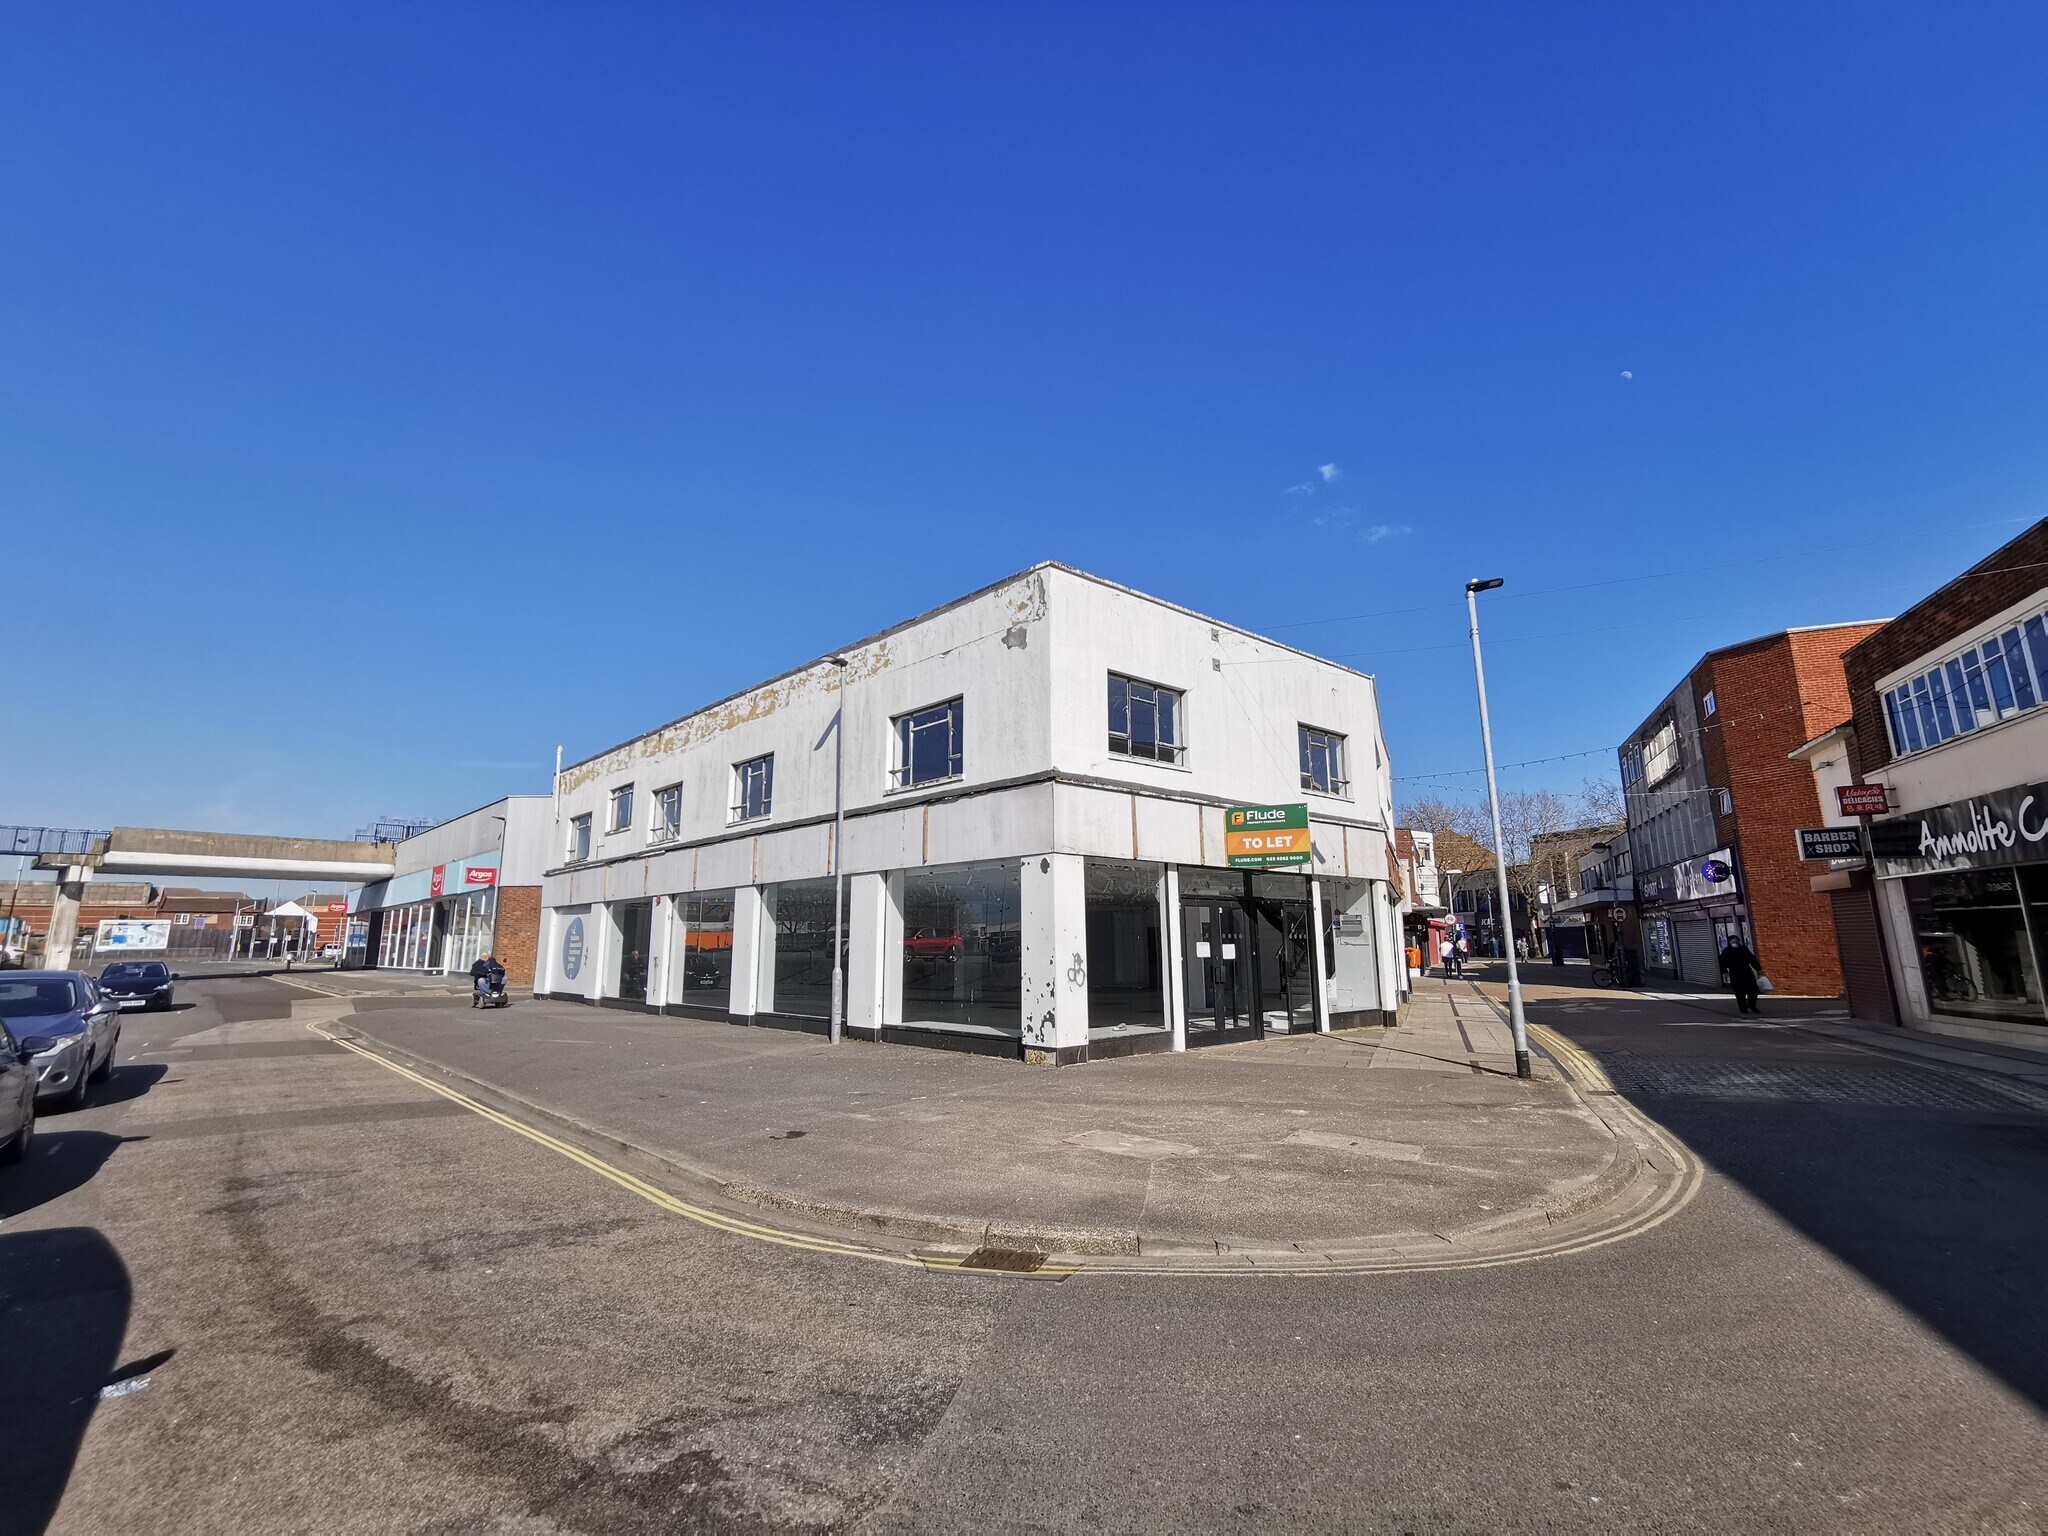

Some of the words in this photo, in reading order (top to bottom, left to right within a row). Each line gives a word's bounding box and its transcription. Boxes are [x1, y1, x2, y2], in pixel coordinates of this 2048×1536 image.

[1842, 796, 1884, 804] DELICACIES
[1246, 809, 1285, 820] Flude
[1918, 800, 2016, 860] Ammolite
[2019, 796, 2048, 841] C
[1243, 837, 1263, 849] TO
[1266, 836, 1292, 848] LET
[1804, 832, 1856, 843] BARBER
[1815, 843, 1850, 853] SHOP
[469, 870, 492, 878] Argos
